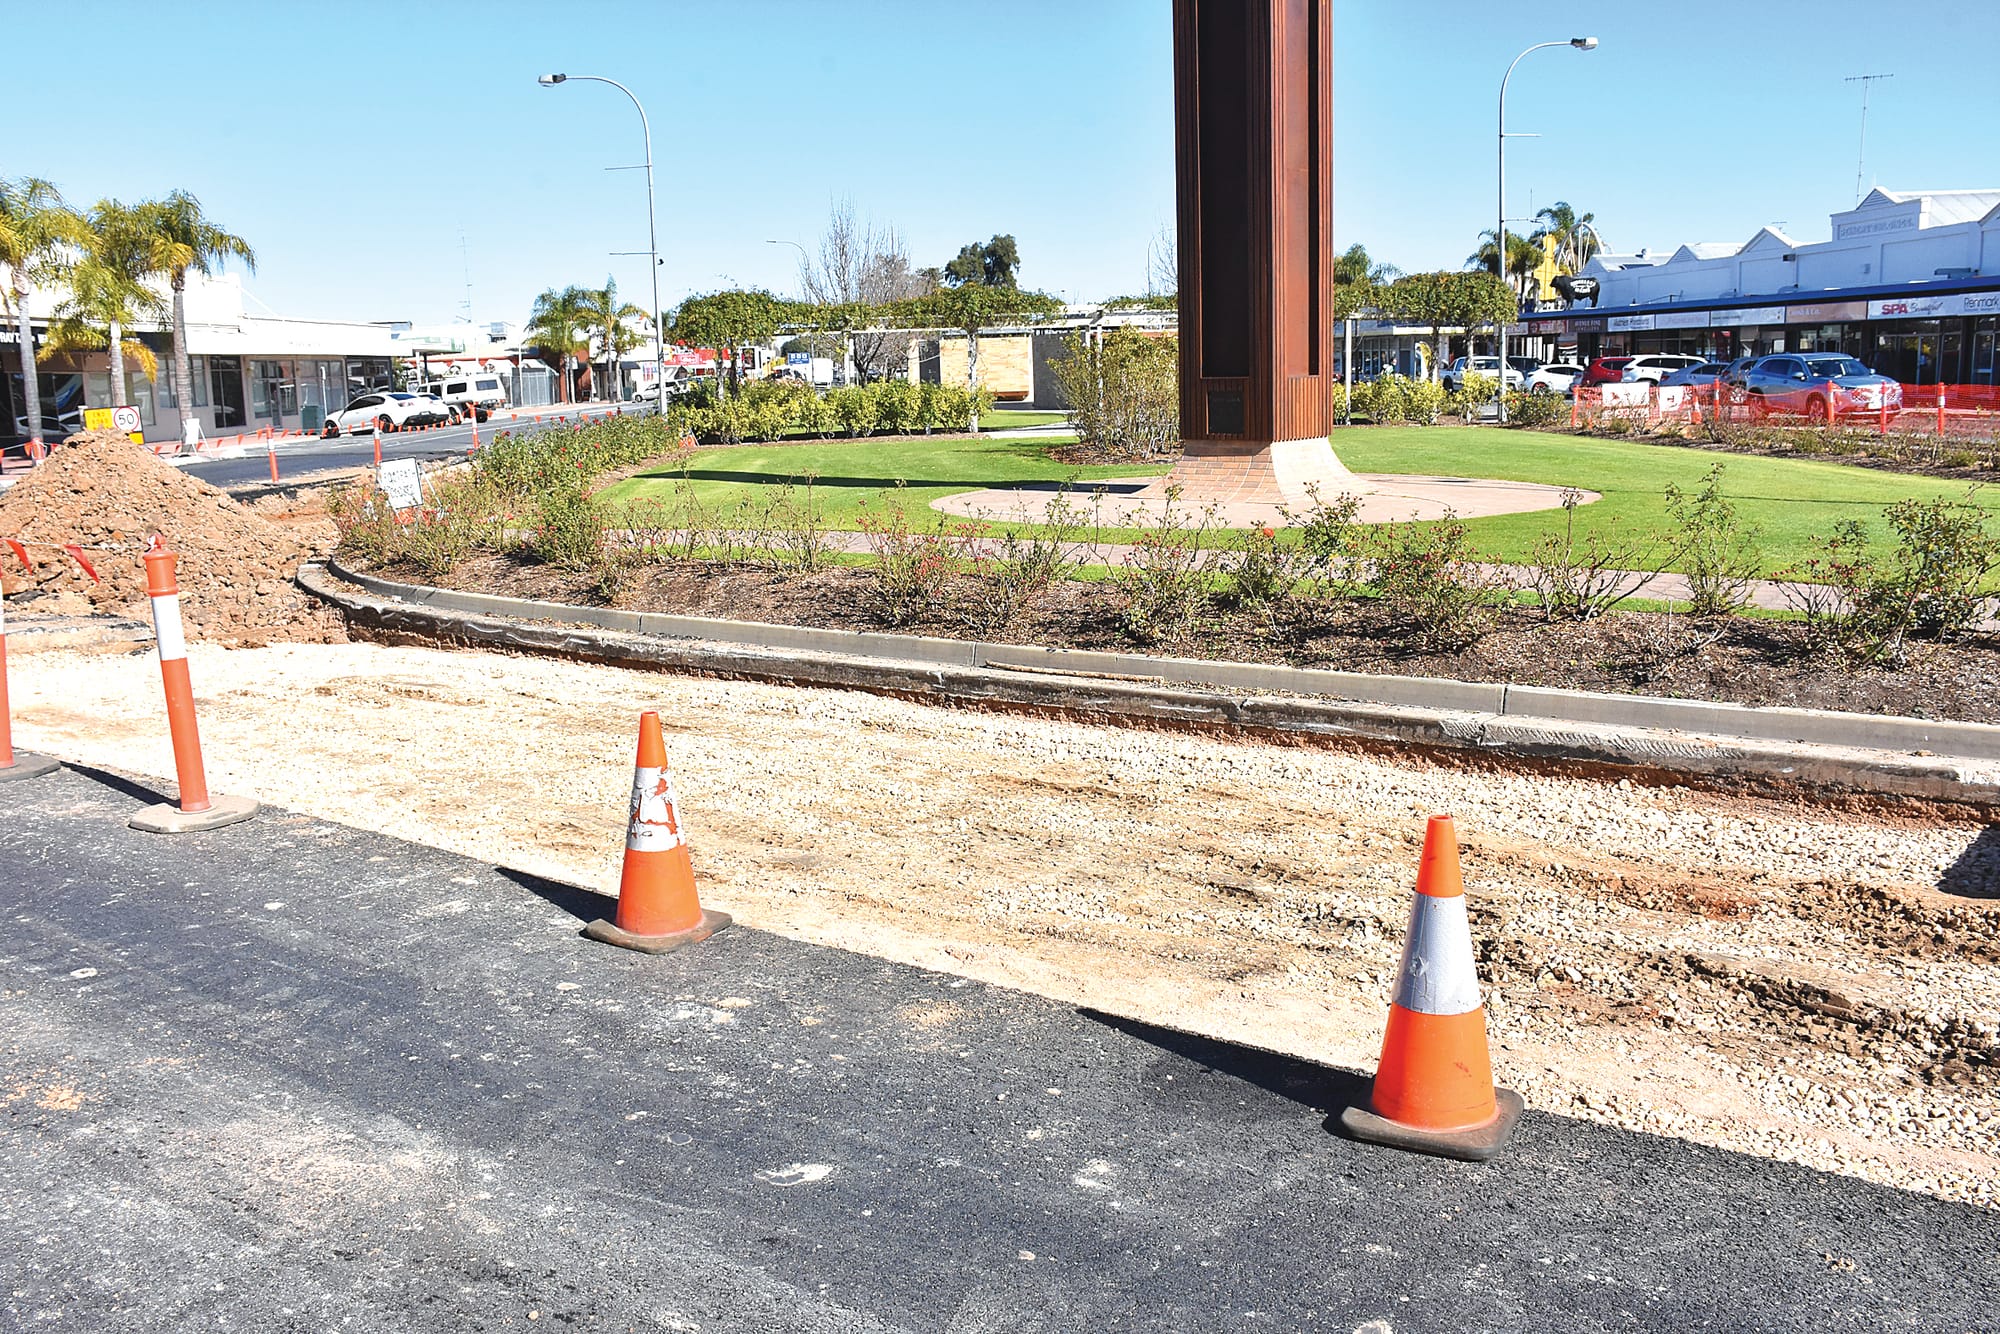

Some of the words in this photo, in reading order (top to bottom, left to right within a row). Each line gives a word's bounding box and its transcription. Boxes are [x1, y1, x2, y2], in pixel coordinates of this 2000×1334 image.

[1964, 296, 2000, 308] Renmark
[1881, 303, 1908, 315] SPA
[118, 413, 135, 425] 50
